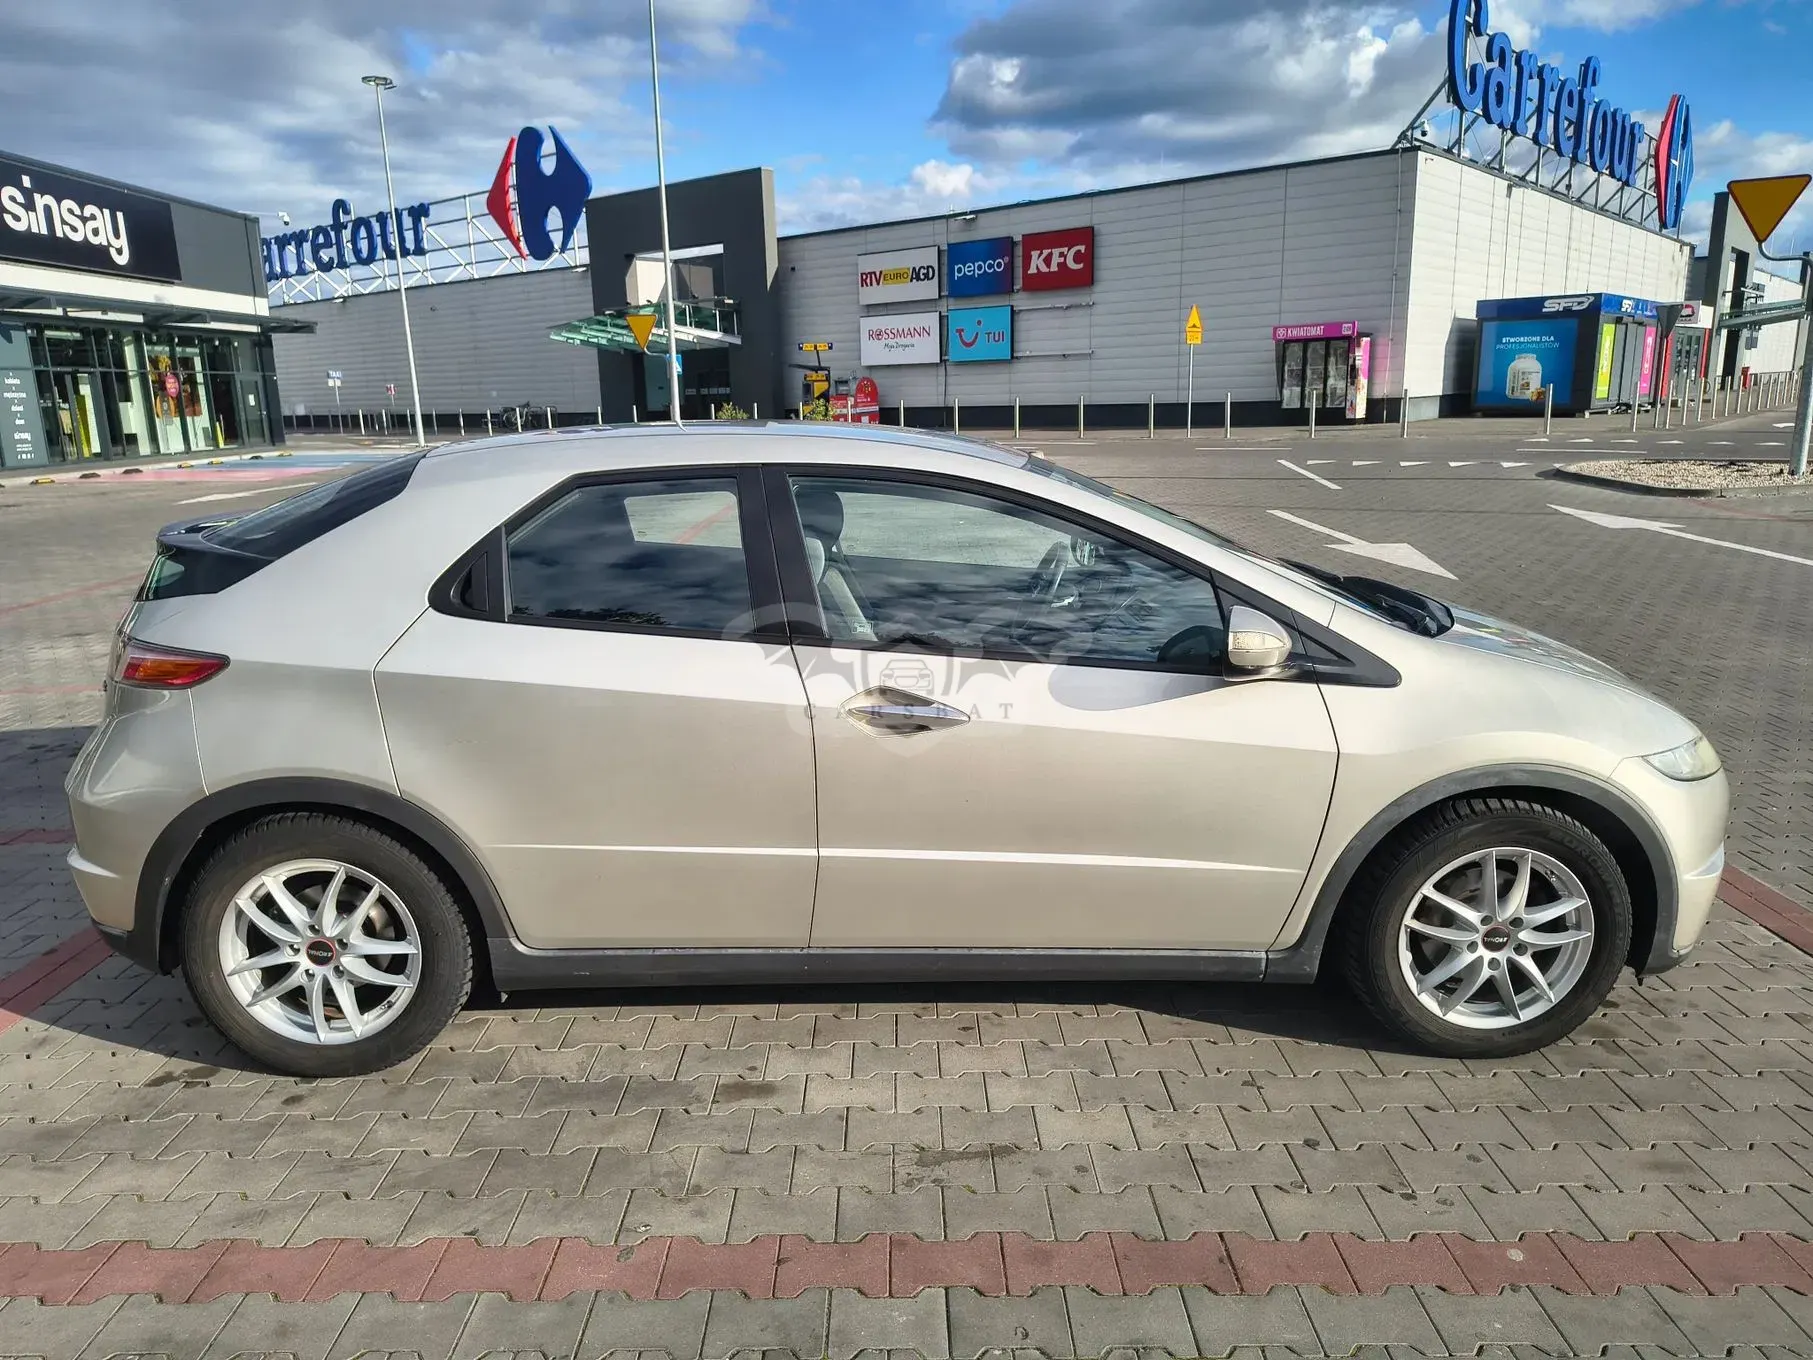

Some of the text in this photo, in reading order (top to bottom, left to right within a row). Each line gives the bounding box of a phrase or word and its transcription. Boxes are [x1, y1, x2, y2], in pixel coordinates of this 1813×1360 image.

[1448, 0, 1644, 187] Carrefour
[1, 175, 130, 266] sinsay
[261, 199, 430, 282] arrefour
[1028, 245, 1085, 274] KFC
[860, 265, 935, 288] RTV EURO AGD
[1542, 295, 1595, 312] SFD
[868, 325, 931, 341] ROSSMANN
[985, 331, 1005, 343] TUI
[1287, 326, 1324, 337] KWIATOMAT
